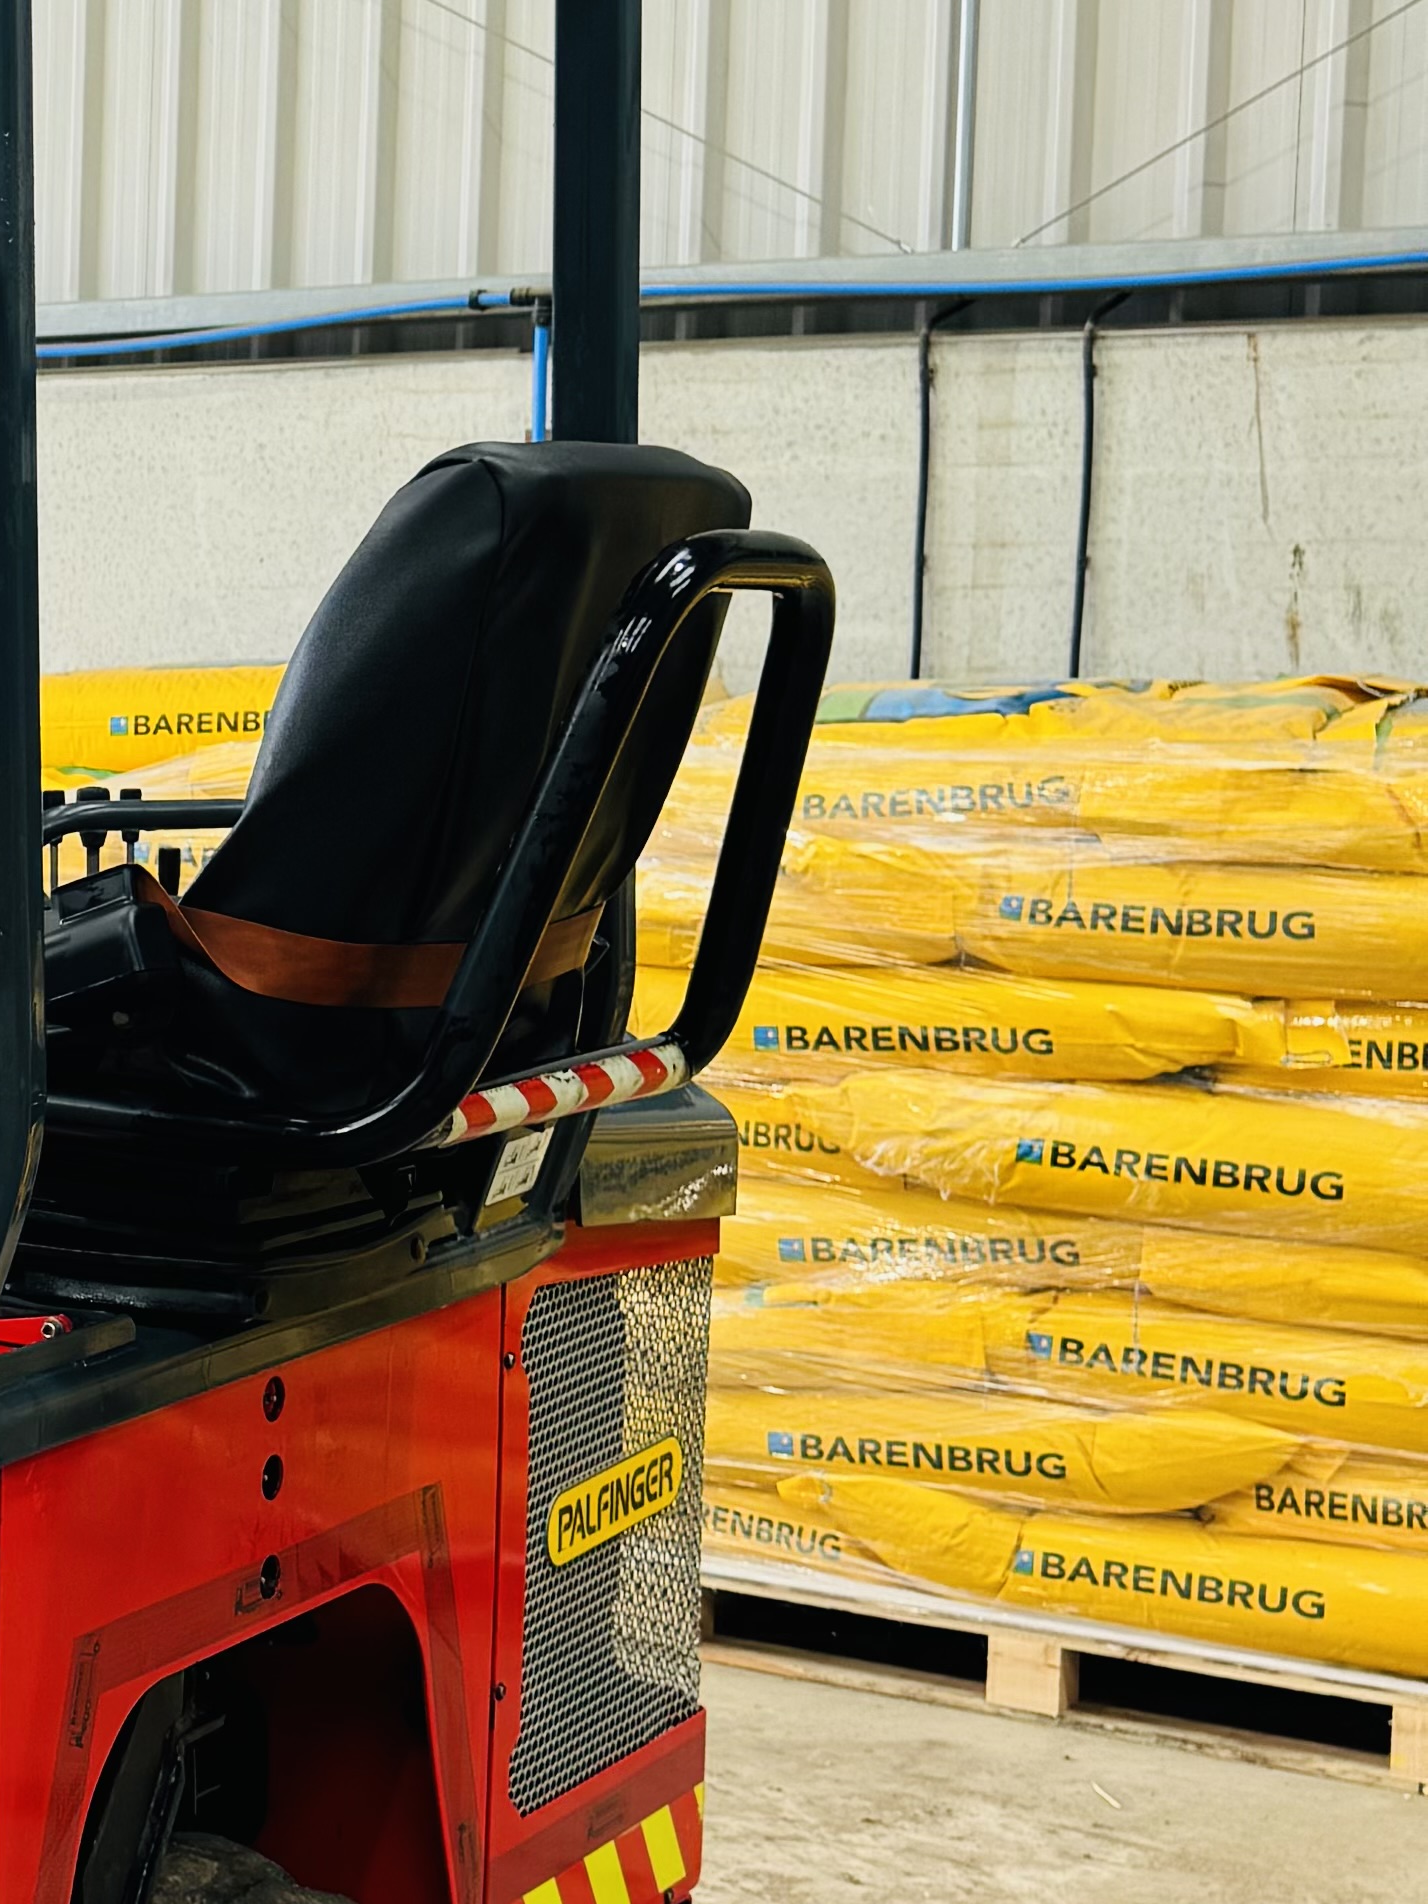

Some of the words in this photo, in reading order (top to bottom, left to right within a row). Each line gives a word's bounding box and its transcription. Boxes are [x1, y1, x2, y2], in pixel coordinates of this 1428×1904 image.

[802, 776, 1071, 820] BARENBRUG
[1028, 898, 1316, 940] BARENBRUG
[785, 1025, 1054, 1056] BARENBRUG
[1050, 1140, 1344, 1201] BARENBRUG
[808, 1237, 1080, 1267] BARENBRUG
[1058, 1337, 1346, 1407] BARENBRUG
[799, 1434, 1067, 1480] BARENBRUG
[557, 1451, 674, 1553] PALFINGER
[1041, 1553, 1325, 1619] BARENBRUG
